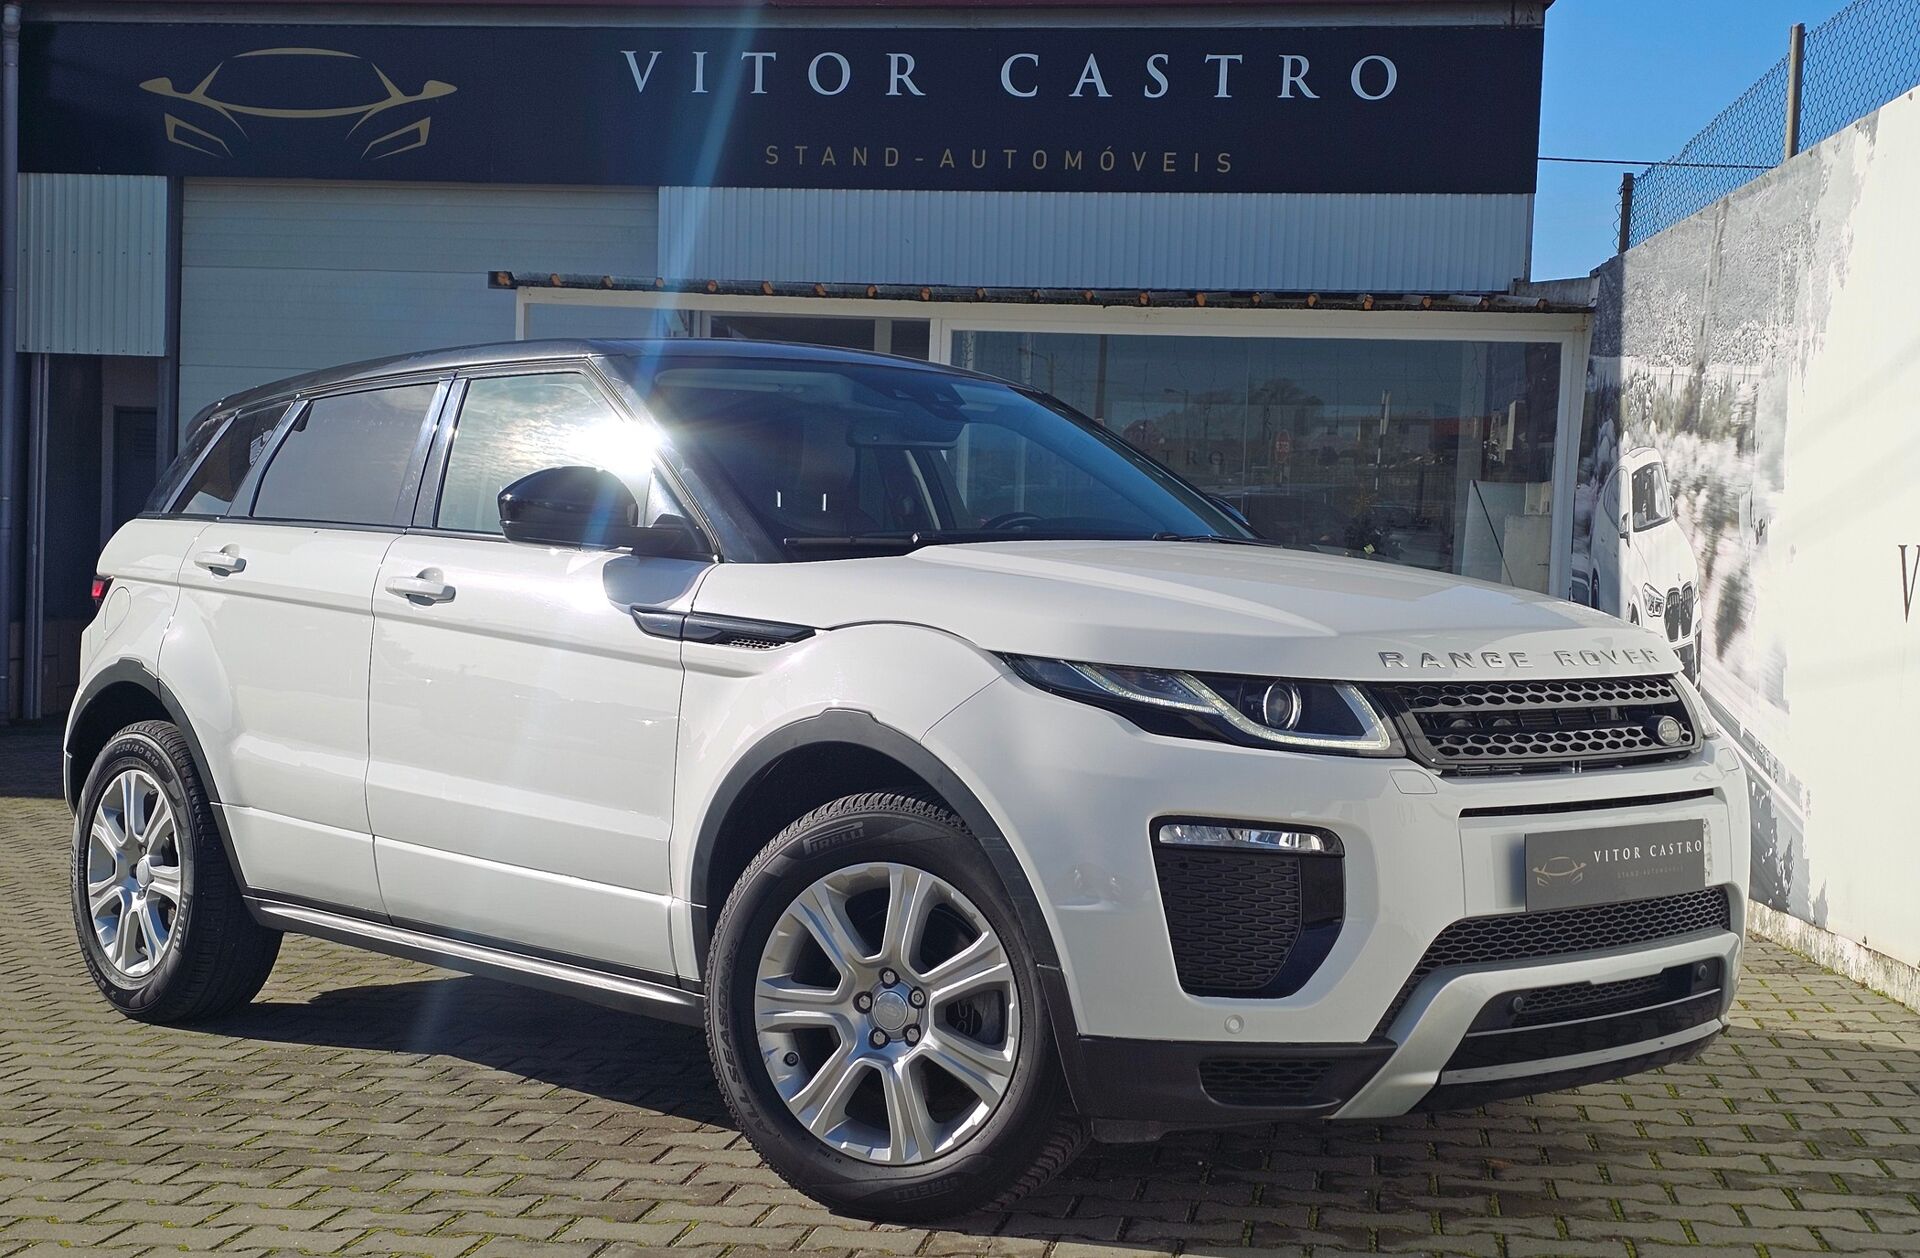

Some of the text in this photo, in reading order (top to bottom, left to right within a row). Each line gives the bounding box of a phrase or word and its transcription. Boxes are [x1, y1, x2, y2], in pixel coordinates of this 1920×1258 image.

[620, 50, 1398, 101] VITOR CASTRO
[764, 145, 1234, 174] STAND-AUTOMÓVEIS
[1378, 648, 1661, 669] RANGE ROVER
[803, 821, 865, 855] PIRELLI
[1594, 839, 1702, 863] VITOR CASTRO
[718, 965, 742, 1084] SEASON
